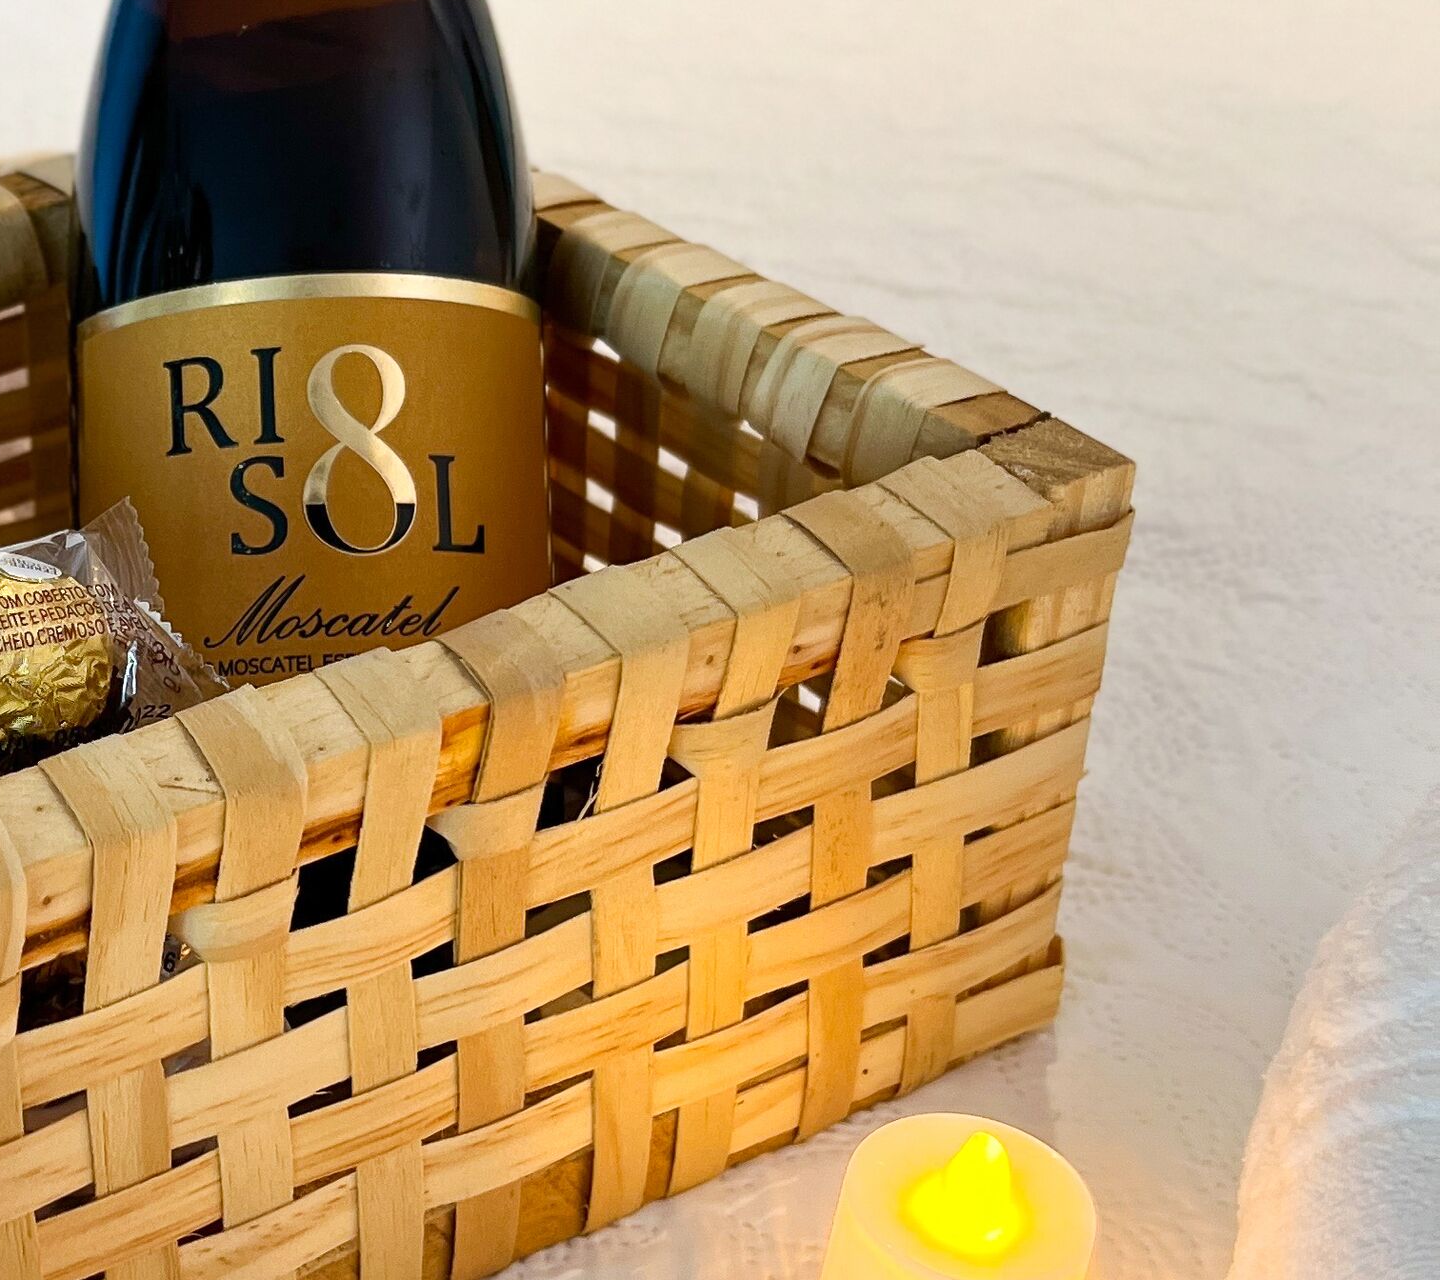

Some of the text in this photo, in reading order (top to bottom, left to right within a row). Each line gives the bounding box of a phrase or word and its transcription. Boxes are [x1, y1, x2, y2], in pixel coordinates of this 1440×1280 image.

[23, 585, 85, 607] COBERTO
[85, 583, 119, 600] COM
[29, 609, 39, 625] E
[203, 573, 461, 650] Moscatel
[36, 618, 106, 648] CREMOSO
[217, 654, 315, 678] MOSCATEL
